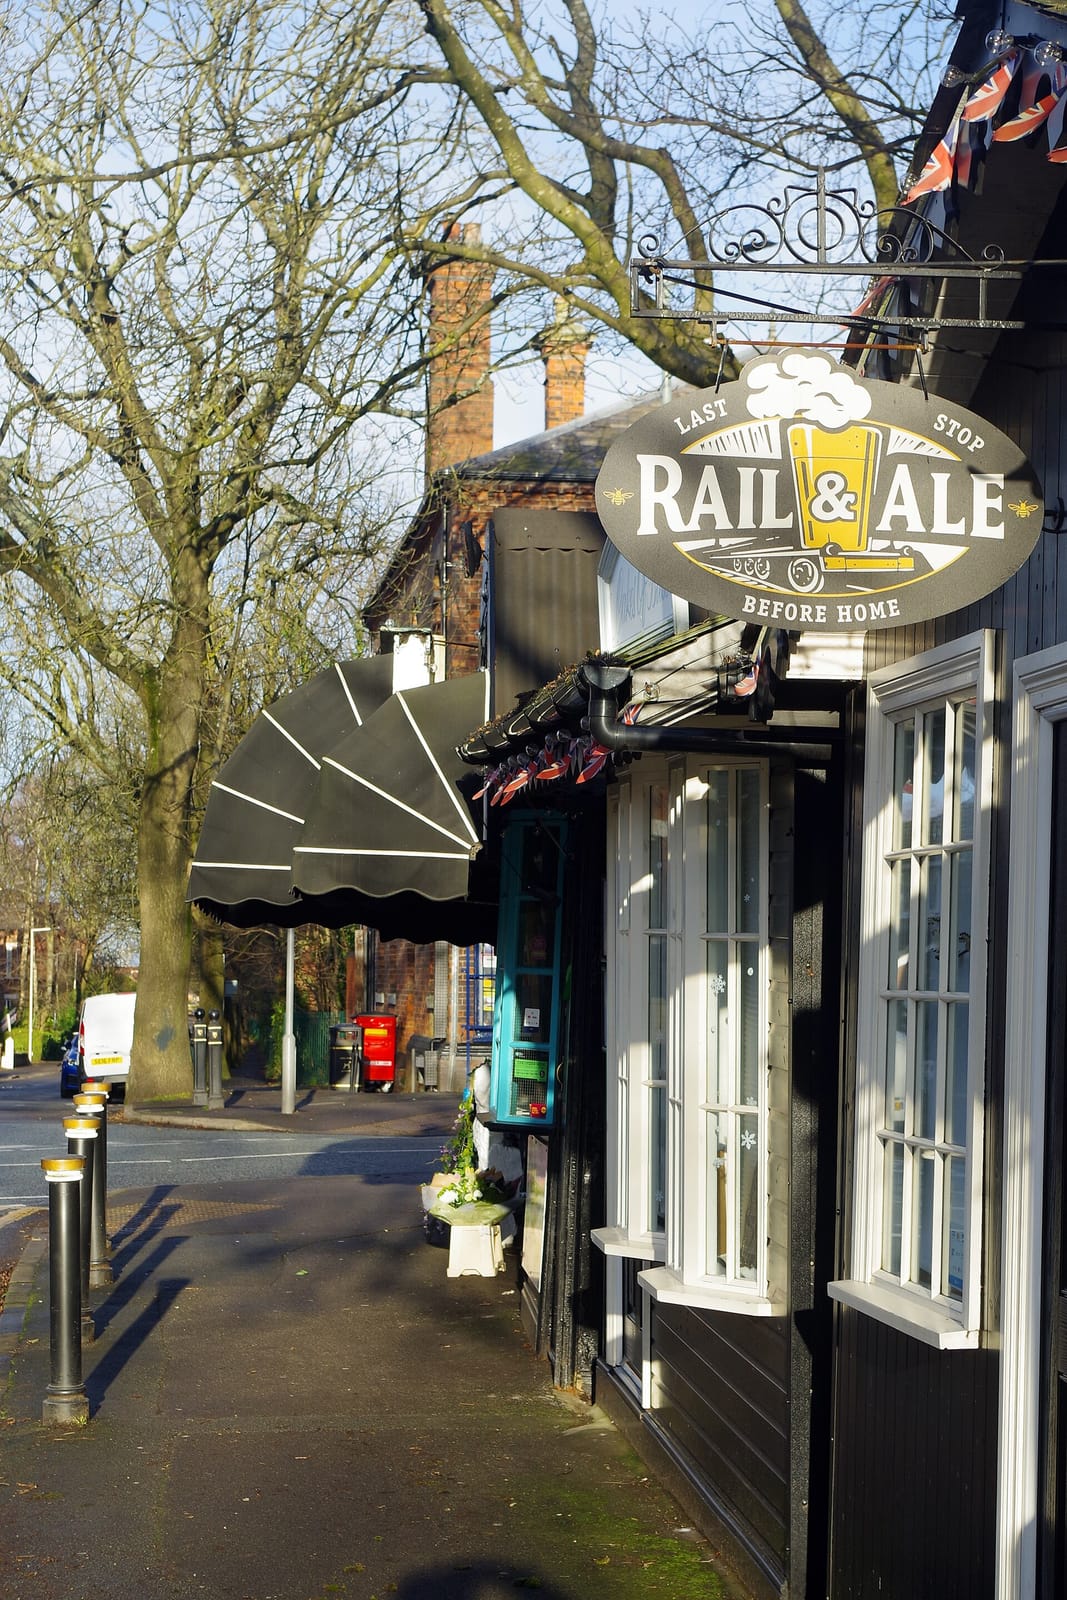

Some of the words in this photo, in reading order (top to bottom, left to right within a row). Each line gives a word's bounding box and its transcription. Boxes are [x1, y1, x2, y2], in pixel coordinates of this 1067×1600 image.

[674, 398, 728, 435] LAST
[933, 414, 985, 452] STOP
[636, 454, 793, 536] RAIL
[811, 472, 855, 520] &
[875, 463, 1005, 540] ALE
[742, 595, 827, 624] BEFORE
[837, 598, 901, 622] HOME
